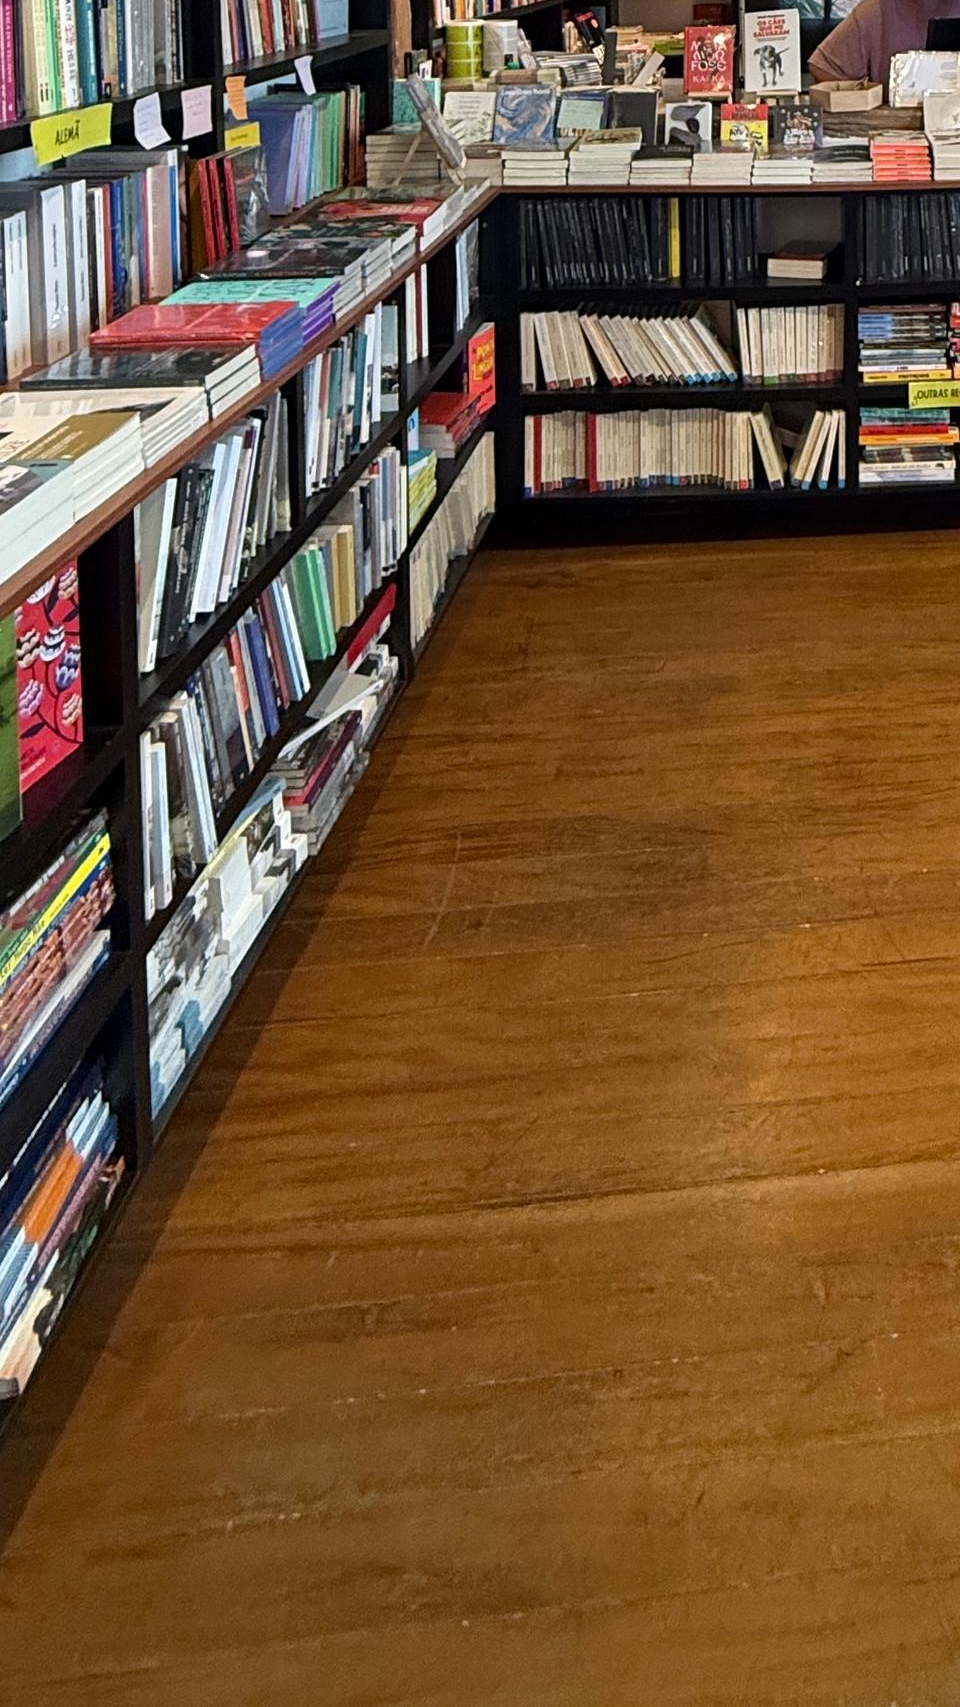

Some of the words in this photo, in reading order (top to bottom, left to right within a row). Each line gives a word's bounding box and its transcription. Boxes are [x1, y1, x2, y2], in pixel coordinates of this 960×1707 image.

[756, 19, 768, 27] OS
[55, 120, 81, 145] ALEMÃ
[916, 388, 948, 400] OUTRAS
